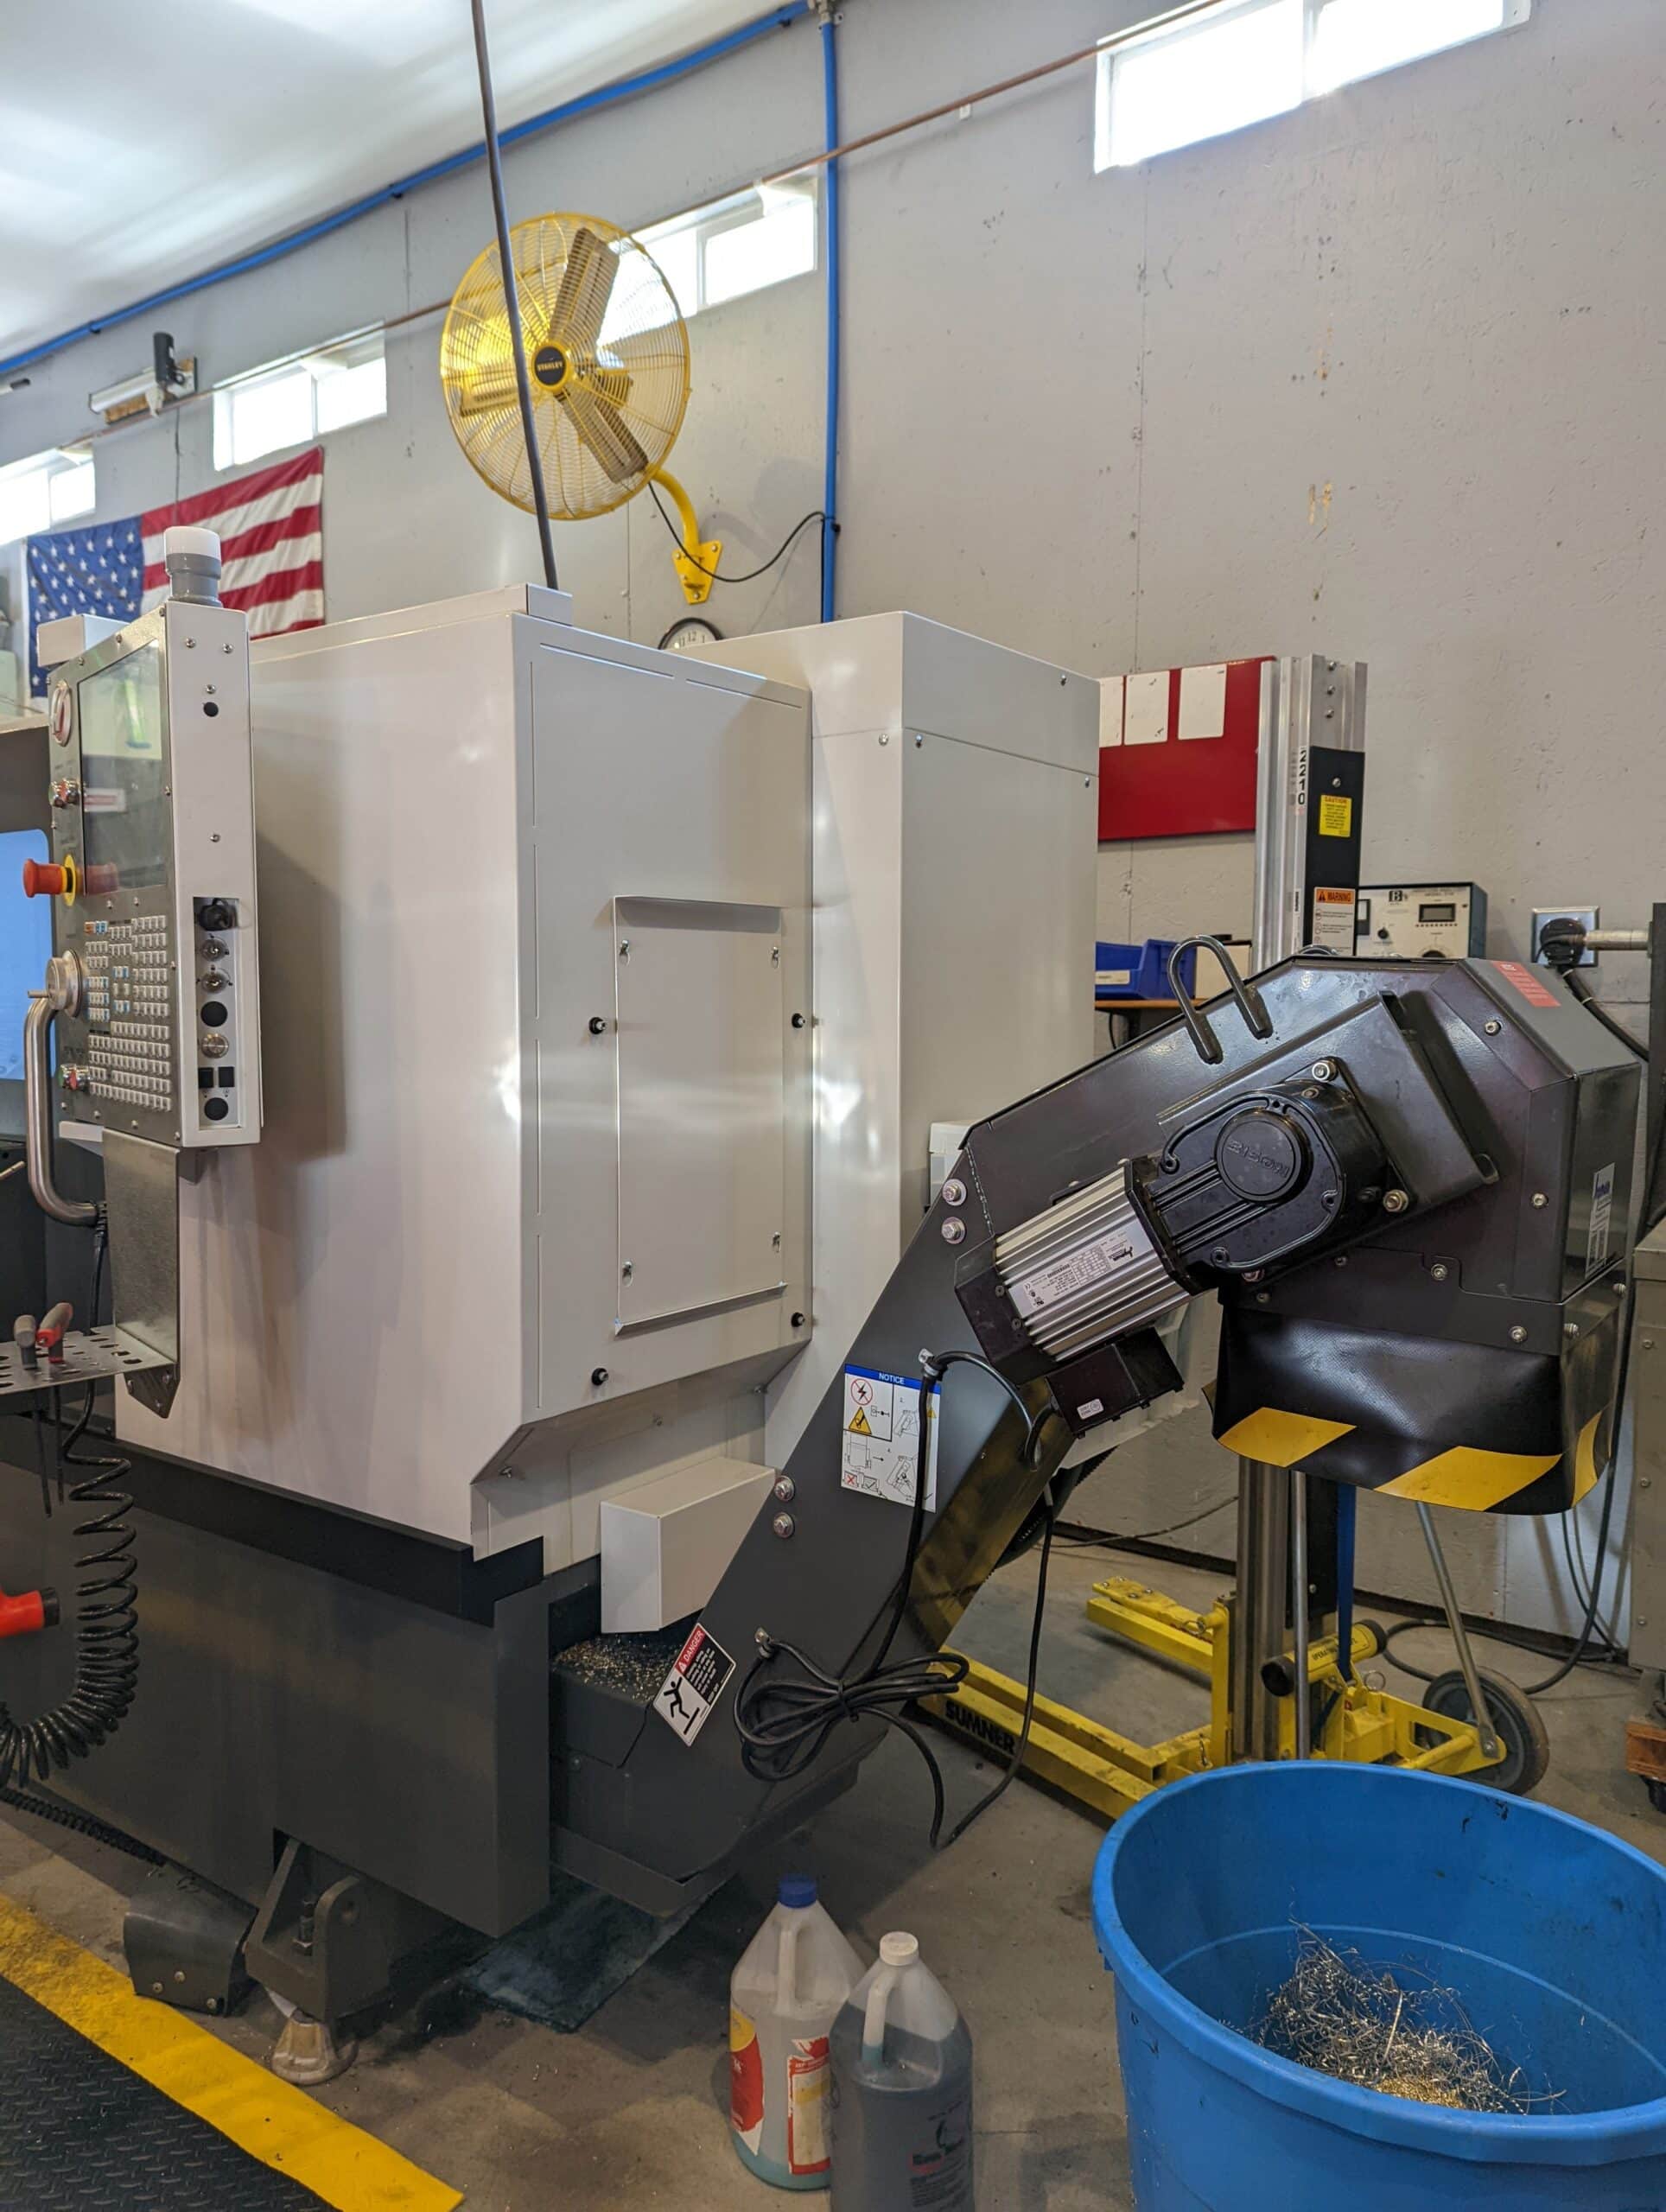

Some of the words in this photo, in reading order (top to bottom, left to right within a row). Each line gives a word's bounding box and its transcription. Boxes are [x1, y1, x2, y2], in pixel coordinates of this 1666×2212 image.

[878, 1372, 905, 1384] NOTICE
[684, 1630, 705, 1661] DANGER
[945, 1700, 1014, 1756] SUMNER
